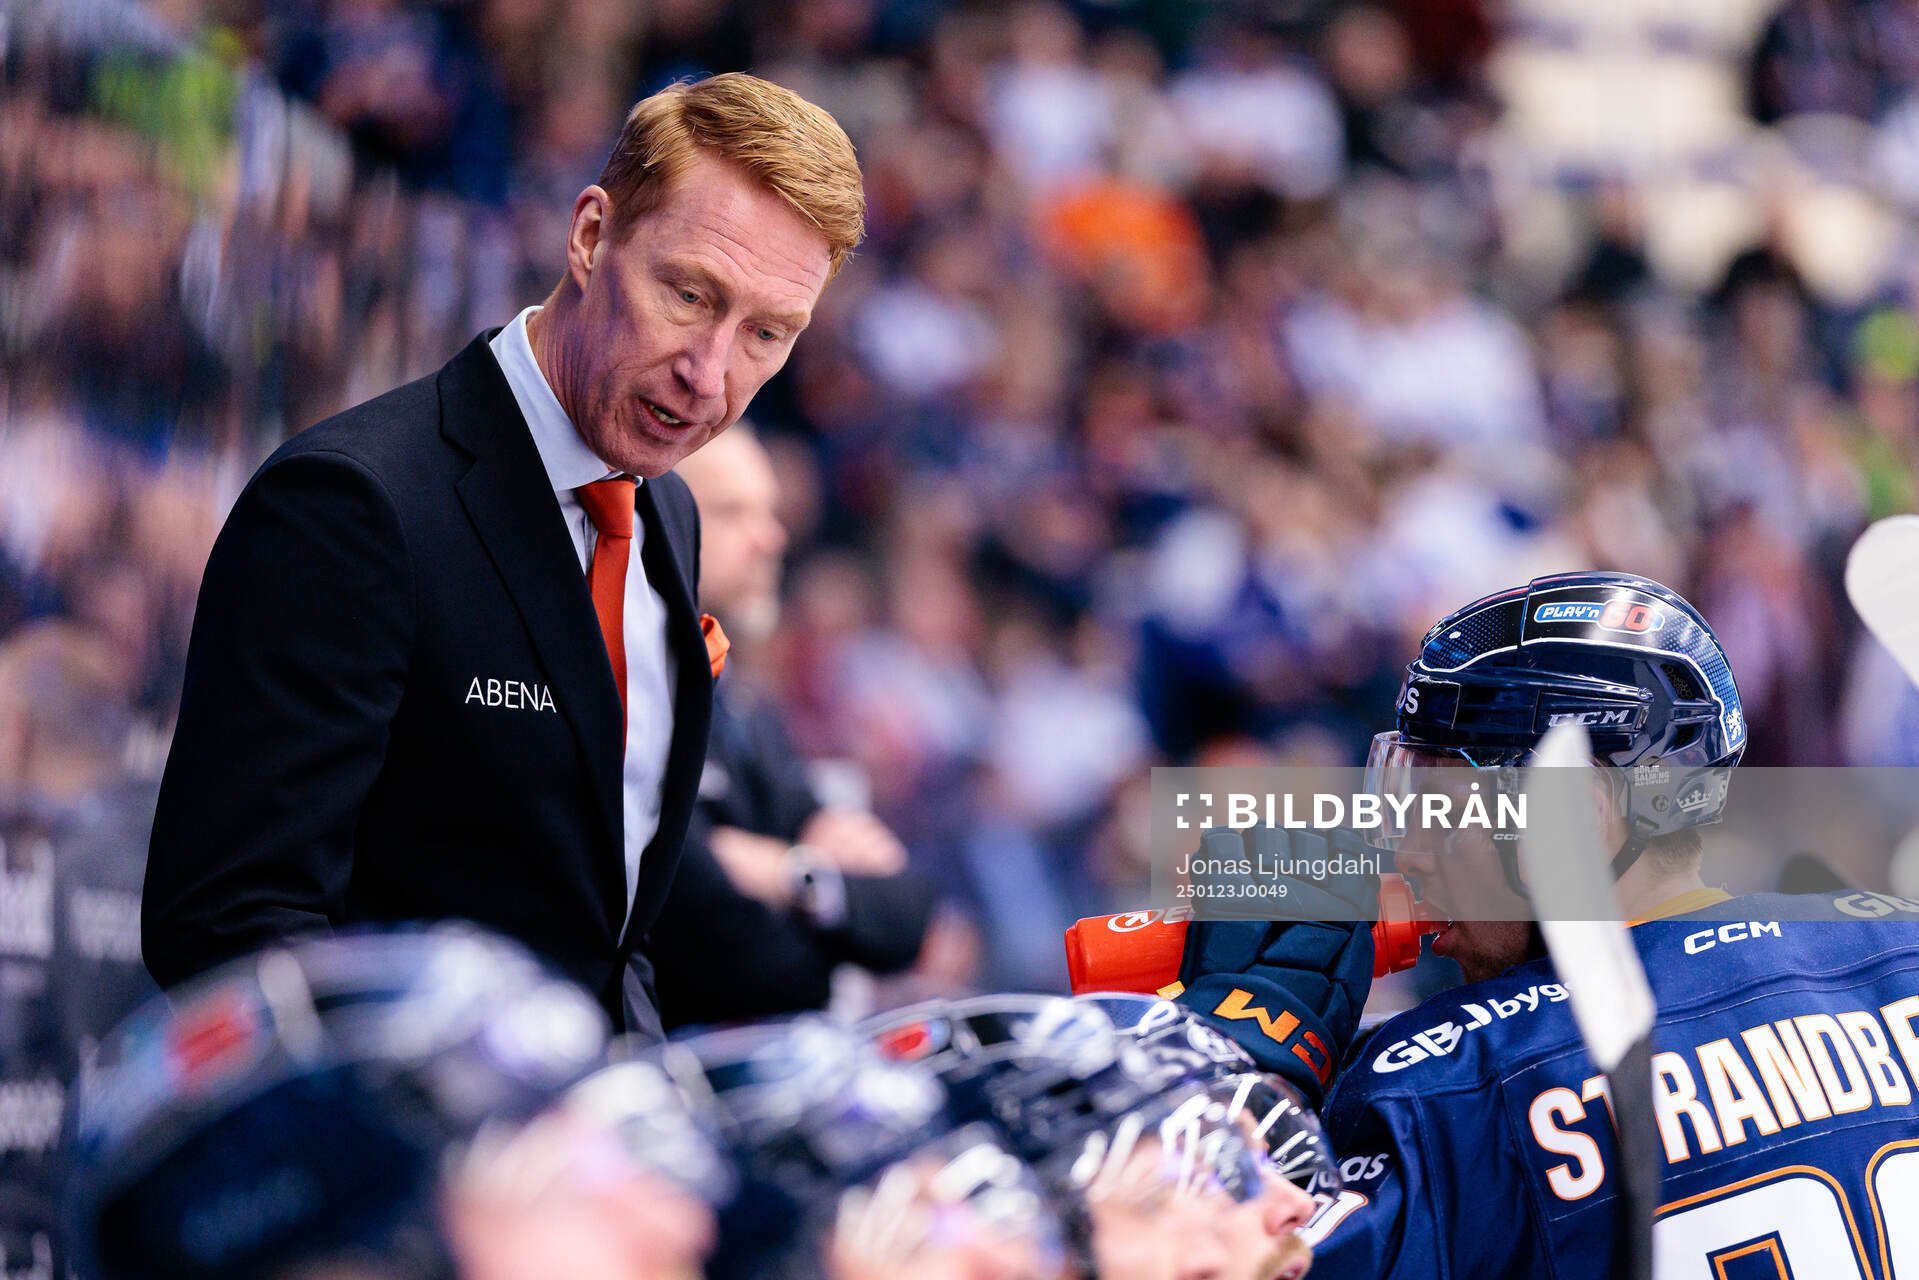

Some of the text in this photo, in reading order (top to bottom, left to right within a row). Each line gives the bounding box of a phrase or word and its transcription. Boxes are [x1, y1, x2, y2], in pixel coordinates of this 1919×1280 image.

[464, 676, 557, 713] ABENA
[1548, 709, 1630, 727] CCM
[1684, 921, 1782, 955] CCM
[1212, 988, 1333, 1088] CM
